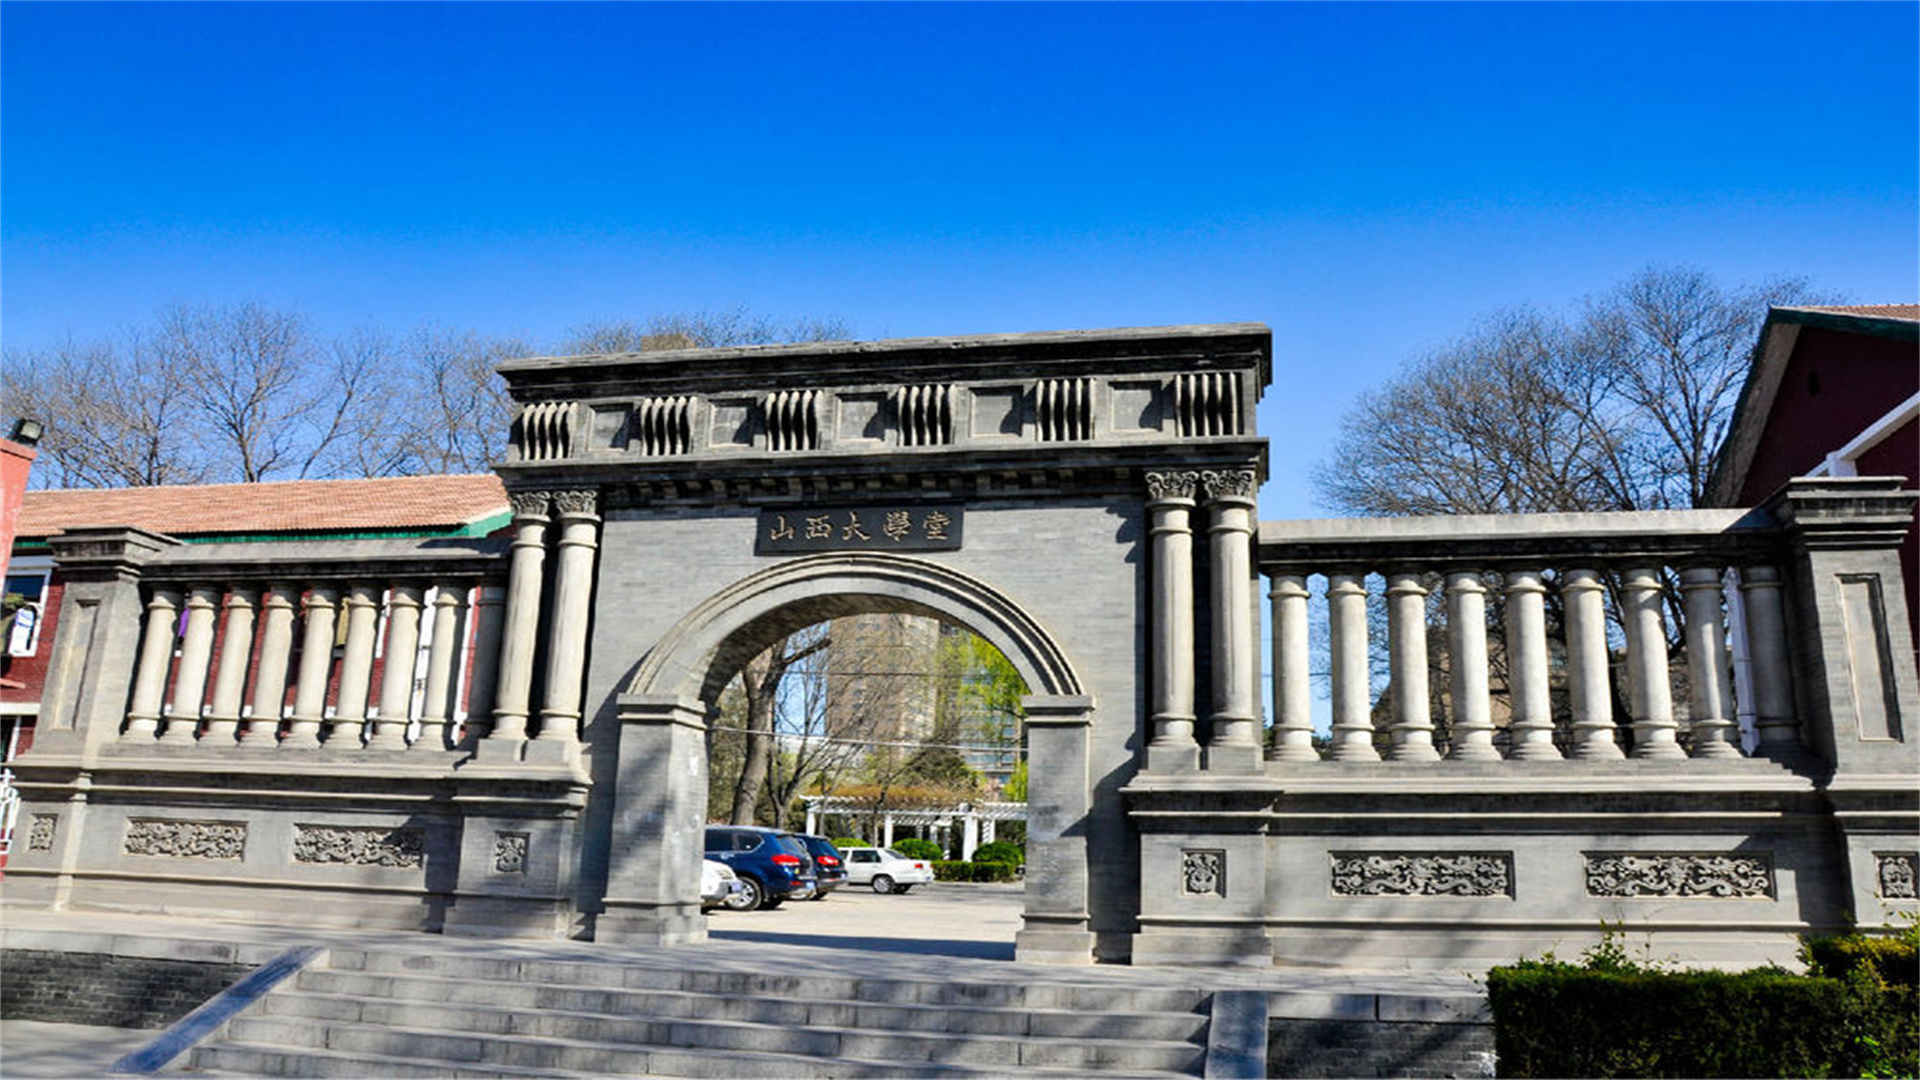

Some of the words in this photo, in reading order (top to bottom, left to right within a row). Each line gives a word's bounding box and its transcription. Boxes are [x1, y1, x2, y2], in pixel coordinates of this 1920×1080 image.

[770, 509, 950, 541] 山西大學堂
